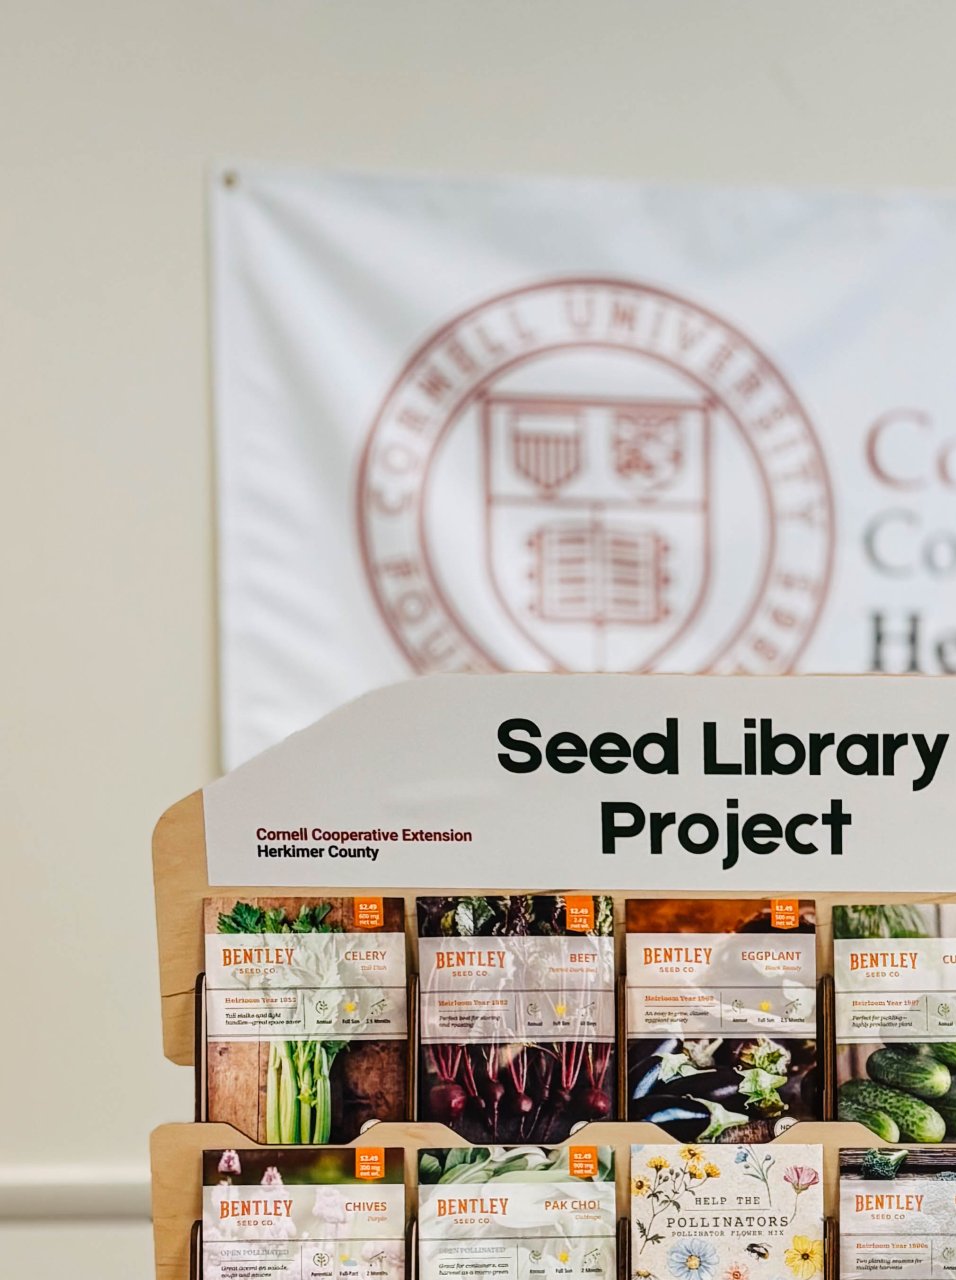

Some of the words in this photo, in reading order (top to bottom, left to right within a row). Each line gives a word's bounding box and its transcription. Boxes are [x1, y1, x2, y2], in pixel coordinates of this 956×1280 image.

[498, 718, 678, 774] Seed
[704, 718, 949, 791] Library
[257, 828, 307, 840] Cornell
[312, 828, 398, 844] Cooperative
[402, 829, 472, 841] Extension
[601, 799, 851, 870] Project
[258, 845, 324, 857] Herkimer
[328, 846, 379, 861] County
[223, 949, 294, 966] BENTLEY
[345, 952, 386, 961] CELERY
[436, 952, 505, 968] BENTLEY
[570, 954, 597, 962] BEET
[644, 948, 712, 965] BENTLEY
[742, 952, 801, 961] EGGPLANT
[850, 953, 918, 970] BENTLEY
[345, 1202, 387, 1211] CHIVES
[438, 1198, 508, 1216] BENTLEY
[545, 1201, 566, 1210] PAK
[571, 1201, 600, 1209] CHOI
[695, 1197, 727, 1205] HELP
[855, 1195, 924, 1212] BENTLEY
[220, 1200, 292, 1219] BENTLEY
[667, 1217, 788, 1227] POLLINATORS
